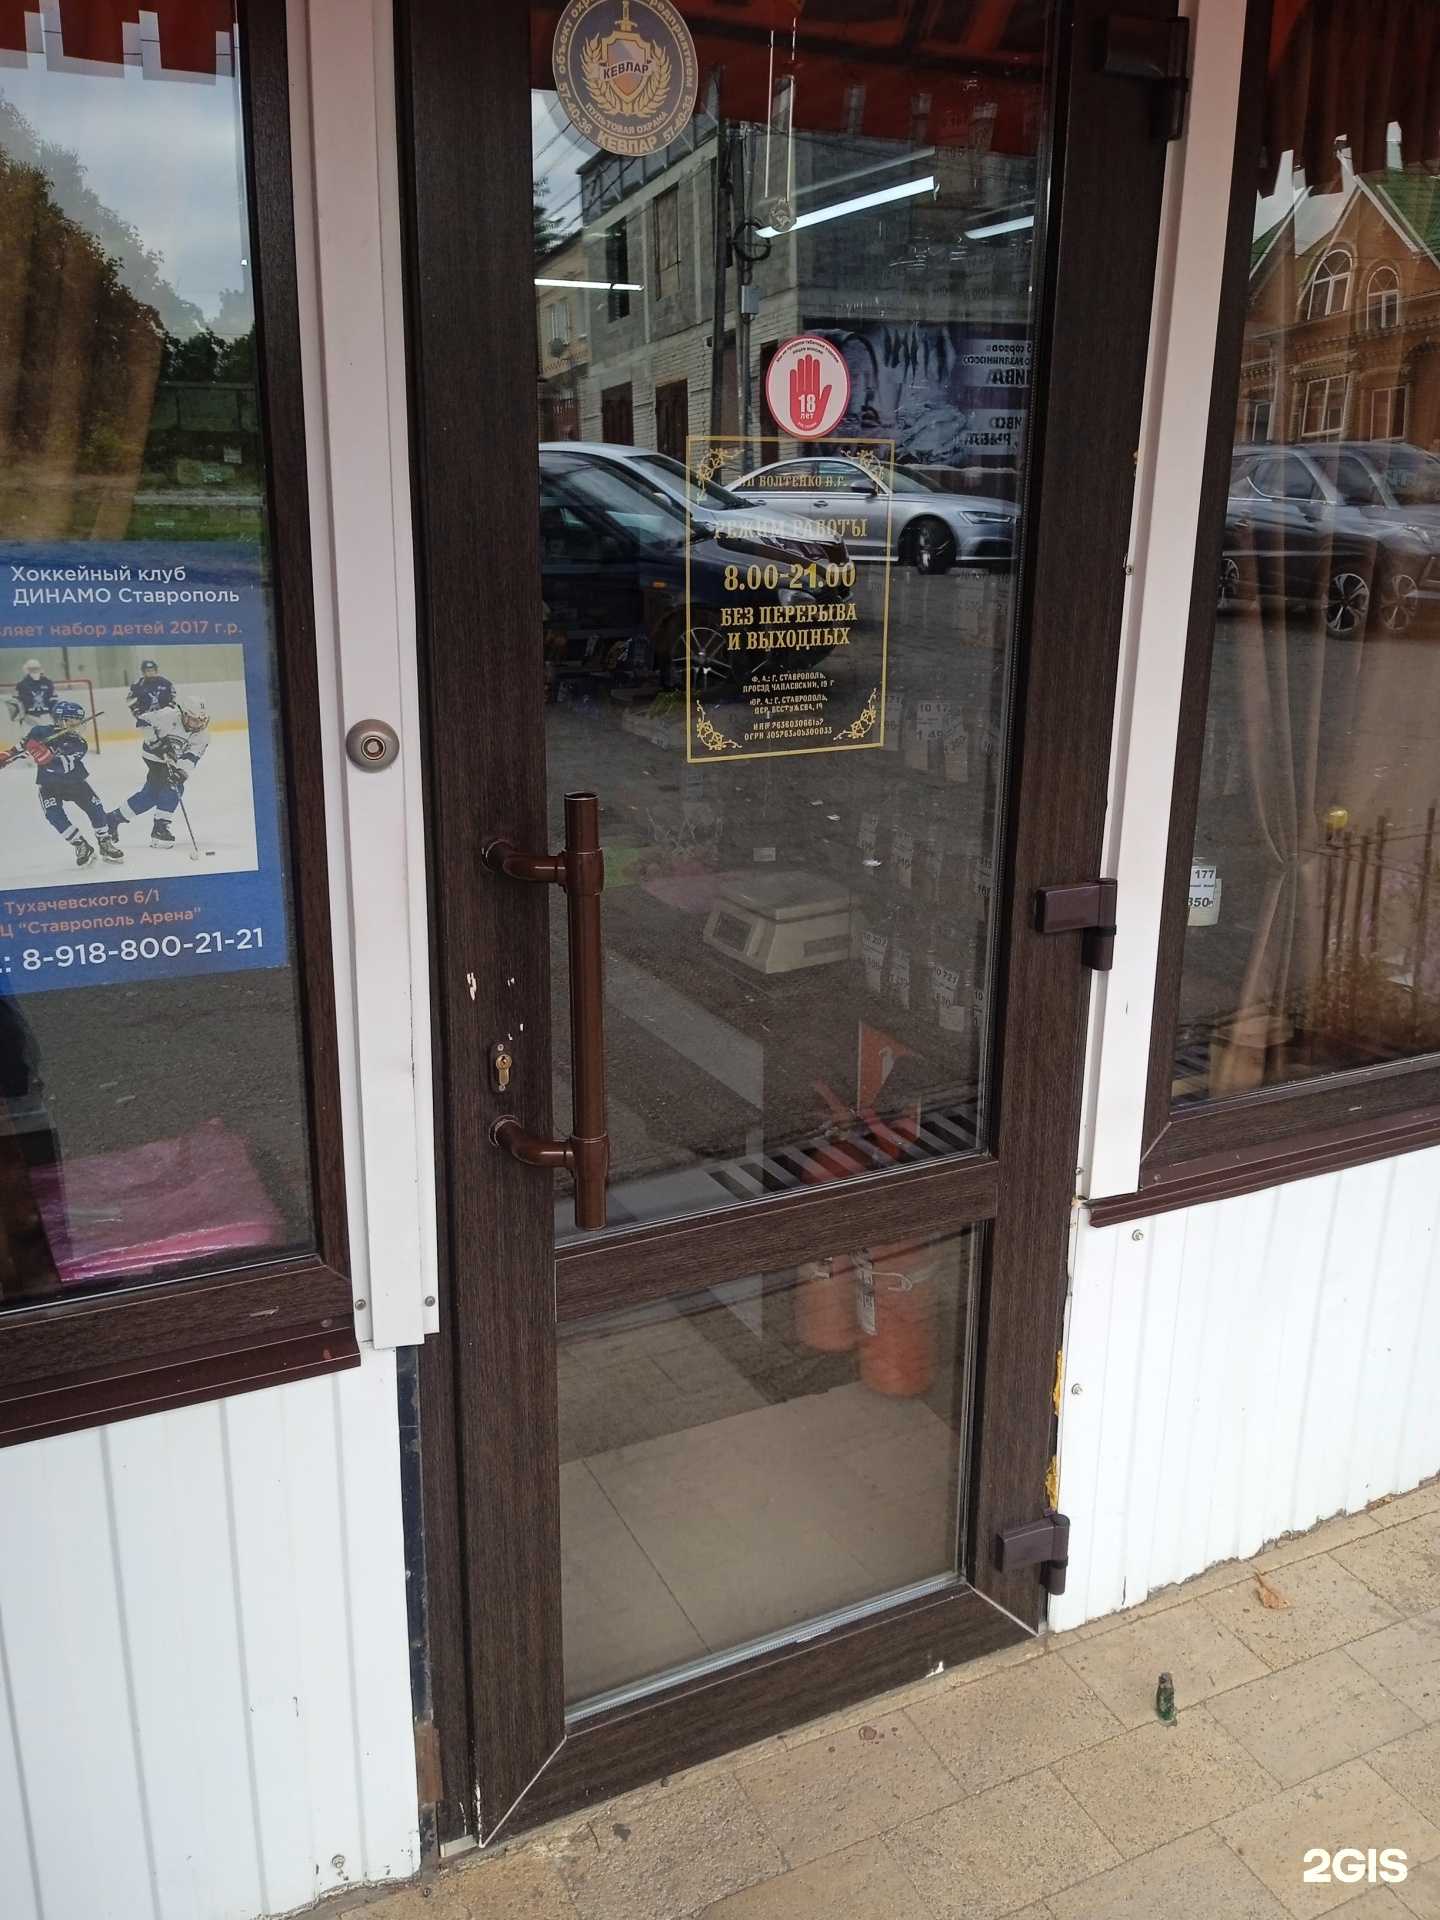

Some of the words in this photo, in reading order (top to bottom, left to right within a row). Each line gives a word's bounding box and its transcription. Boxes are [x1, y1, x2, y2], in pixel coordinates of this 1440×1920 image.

[603, 62, 649, 79] КЕВЛАР
[597, 132, 657, 153] КЕВЛАР
[798, 394, 816, 413] 18
[713, 520, 787, 539] РЕЖИМ
[792, 518, 869, 537] РАБОТЫ
[10, 565, 131, 582] Хоккейный
[138, 566, 186, 584] клуб
[724, 561, 856, 591] 8.00-21.00
[13, 588, 111, 606] ДИНАМО
[118, 587, 240, 605] Ставрополь
[720, 607, 754, 626] БЕЗ
[759, 603, 858, 624] ПЕРЕРЫВА
[50, 622, 107, 638] набор
[112, 621, 165, 636] детей
[171, 620, 209, 635] 2017
[214, 623, 243, 636] г.р.
[727, 632, 741, 651] И
[746, 627, 850, 652] ВЫХОДНЫХ
[4, 892, 129, 917] Тухачевского
[133, 888, 161, 905] 6/1
[22, 927, 263, 971] 8-918-800-21-21
